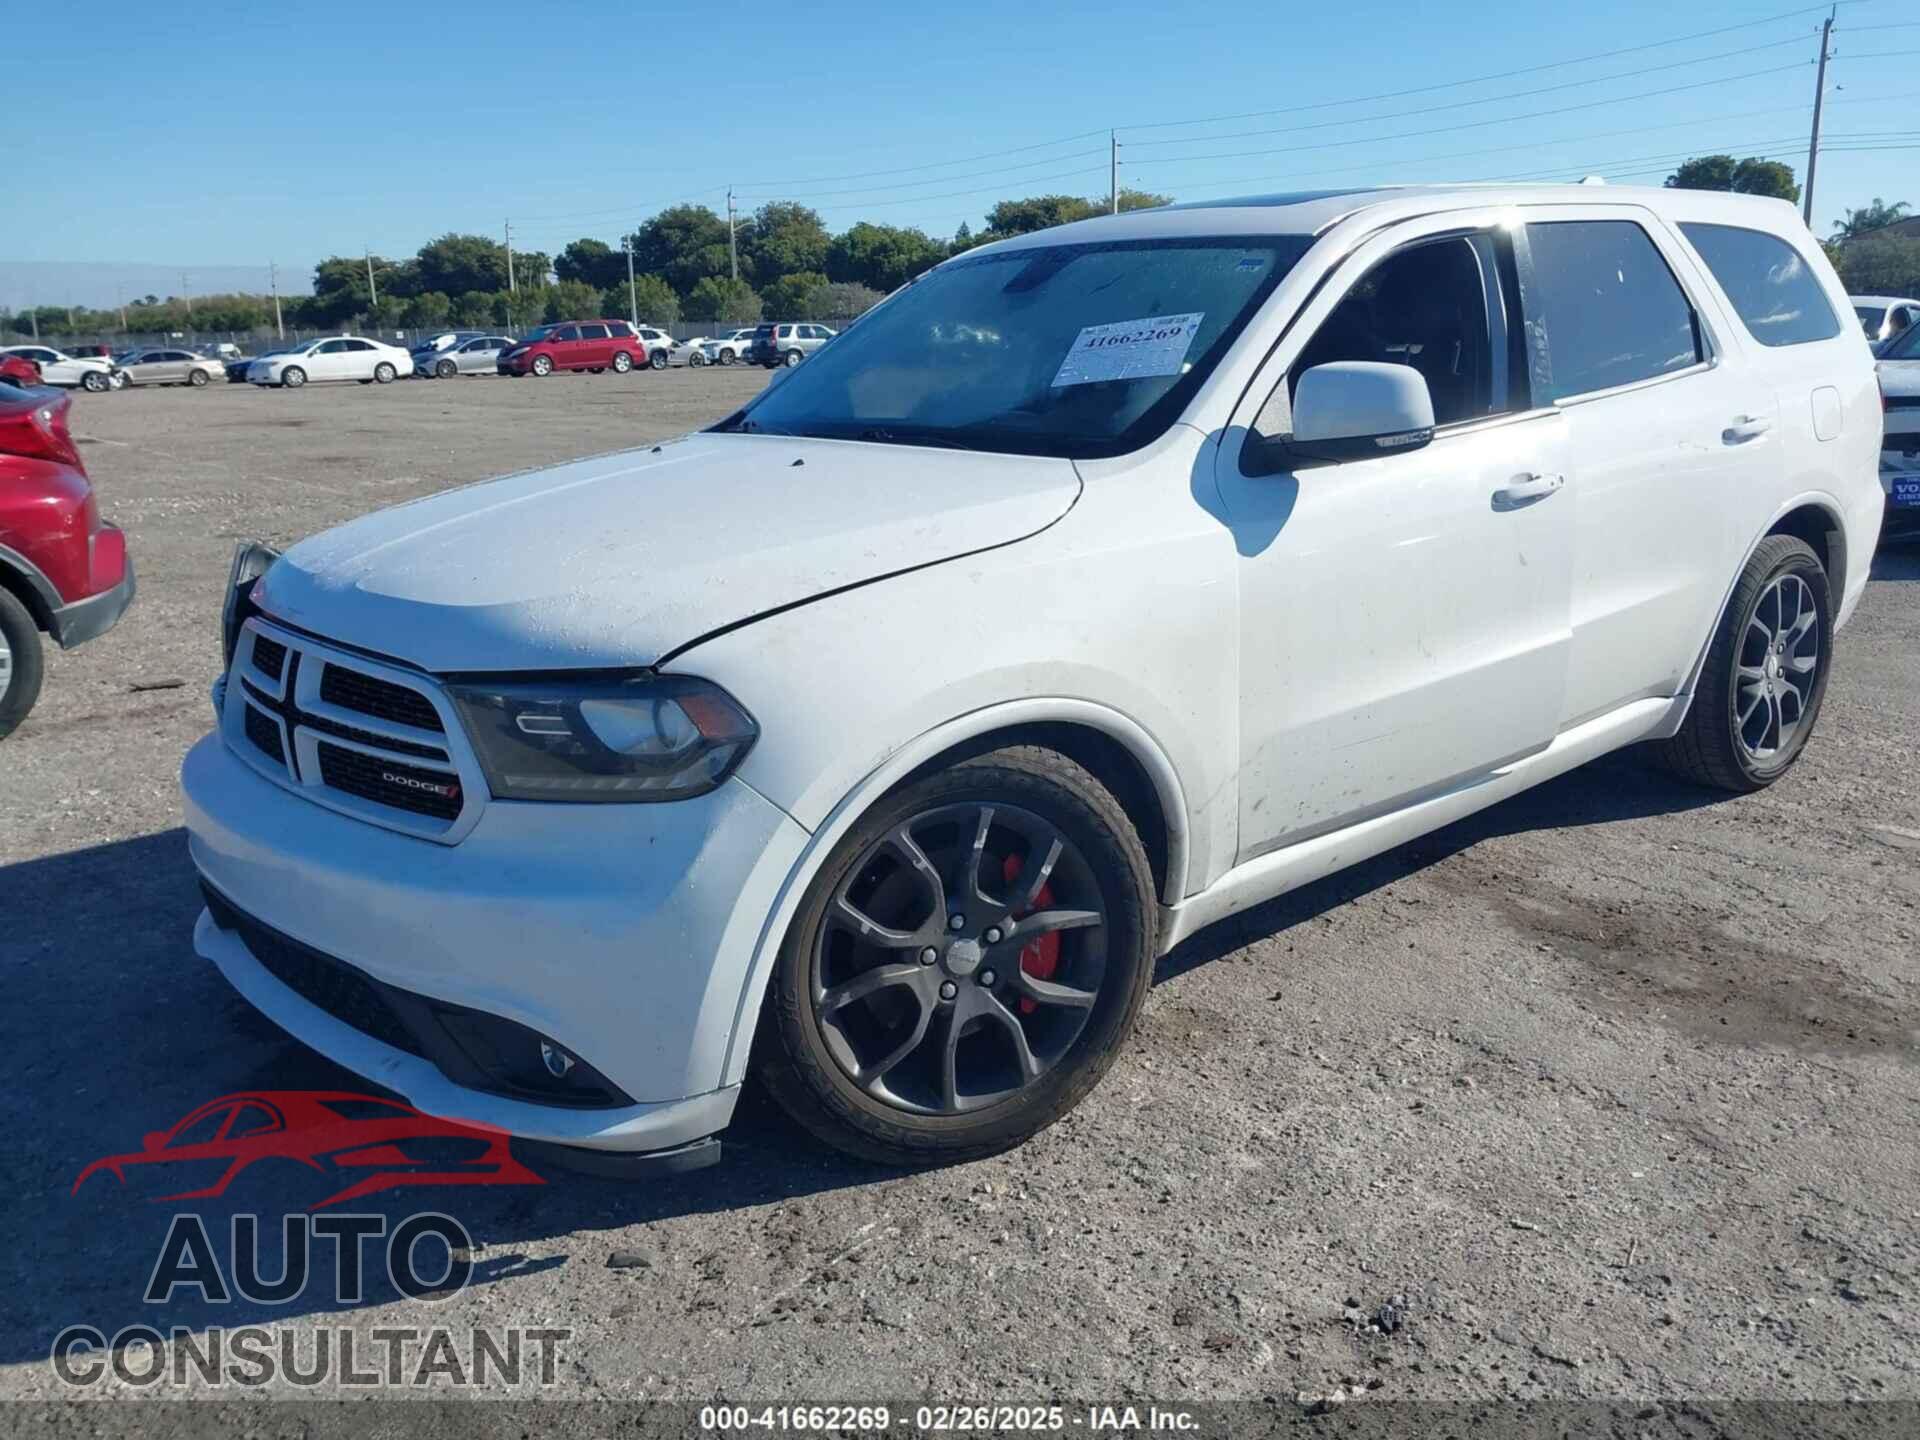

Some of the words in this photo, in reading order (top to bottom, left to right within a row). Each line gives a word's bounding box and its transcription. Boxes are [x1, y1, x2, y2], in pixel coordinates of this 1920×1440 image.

[1085, 327, 1182, 348] 41662269
[1896, 484, 1920, 493] VO
[383, 773, 449, 796] DODGE
